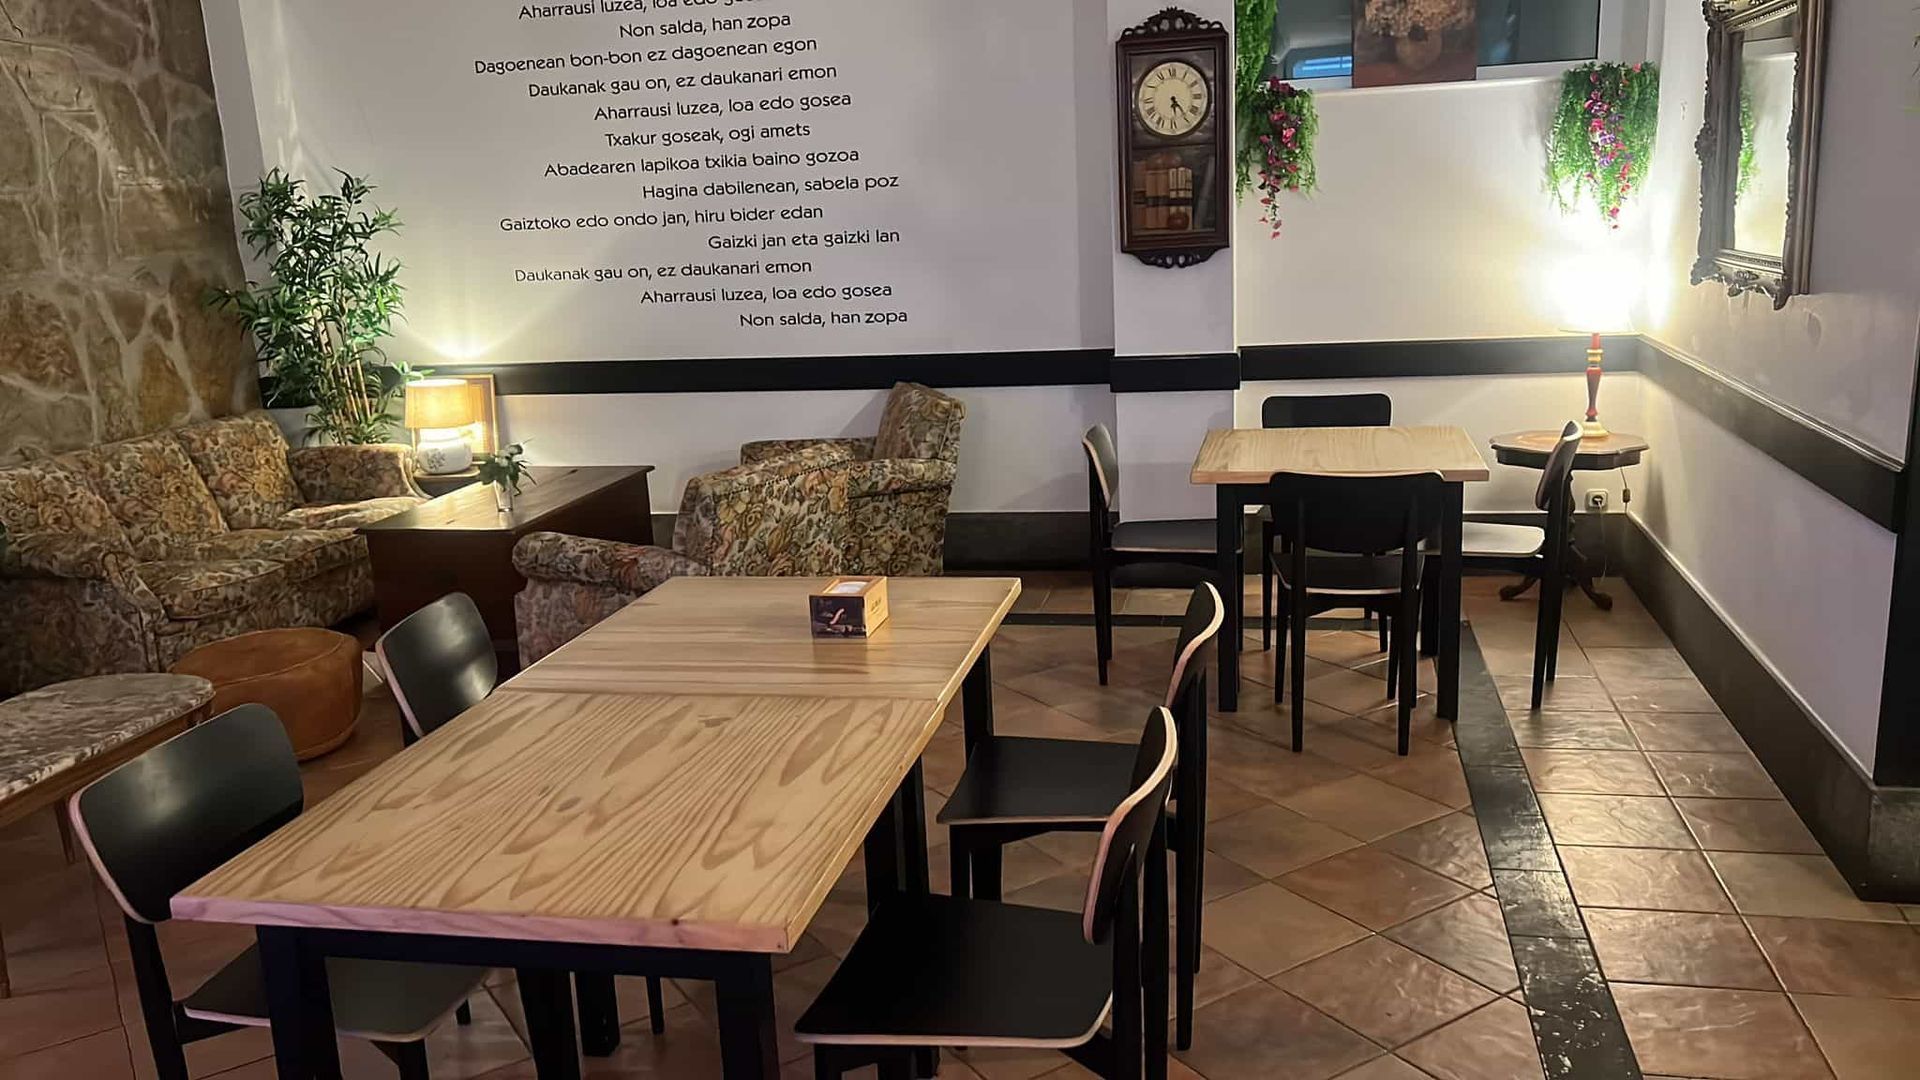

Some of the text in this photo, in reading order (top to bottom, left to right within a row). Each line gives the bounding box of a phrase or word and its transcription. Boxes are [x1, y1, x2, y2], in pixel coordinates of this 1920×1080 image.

[519, 0, 595, 19] Aharrausi
[601, 0, 647, 13] luzea,
[620, 15, 791, 38] Non salda, han zopa
[475, 40, 817, 75] Dagoenean bon-bon ez dagoenean egon
[529, 67, 836, 97] Daukanak gau on, ez daukanari emon
[594, 95, 851, 120] Aharrausi luzea, loa edo gosea
[604, 123, 810, 147] Txakur goseak, ogi amets
[544, 151, 859, 177] Abadearen lapikoa txikia baino gozoa
[643, 176, 899, 200] Hagina dabilenean, sabela poz
[500, 205, 823, 231] Gaiztoko edo ondo jan, hiru bider edan
[708, 229, 899, 250] Gaizki jan eta gaizki lan
[515, 261, 811, 282] Daukanak gau on, ez daukanari emon
[641, 285, 892, 304] Aharrausi luzea, loa edo gosea
[740, 311, 907, 328] Non salda, han zopa
